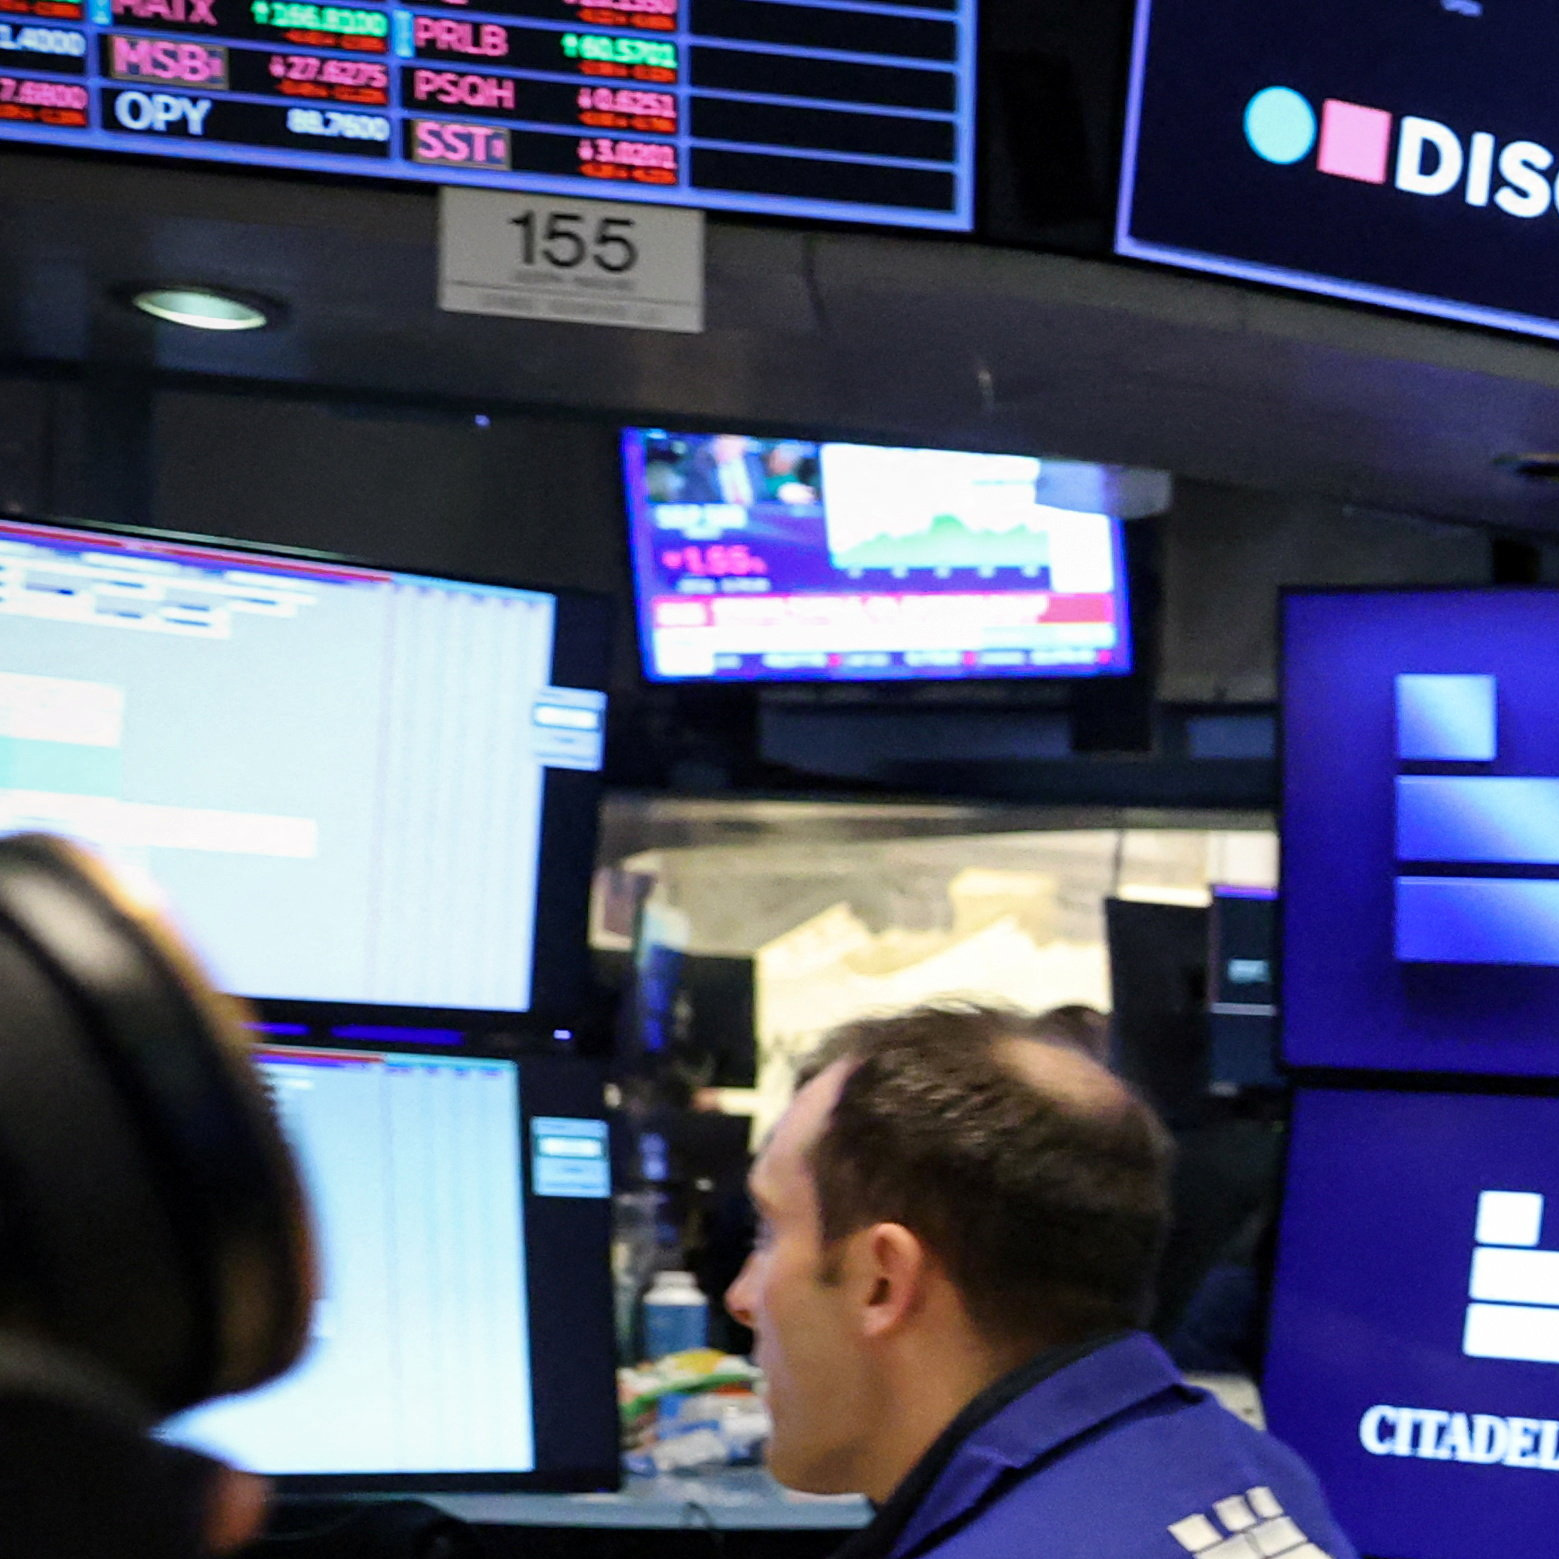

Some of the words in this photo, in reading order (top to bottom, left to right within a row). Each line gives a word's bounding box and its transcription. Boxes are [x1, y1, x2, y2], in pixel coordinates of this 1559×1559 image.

[413, 16, 509, 57] PRLB
[114, 91, 212, 135] OPY
[509, 209, 639, 273] 155
